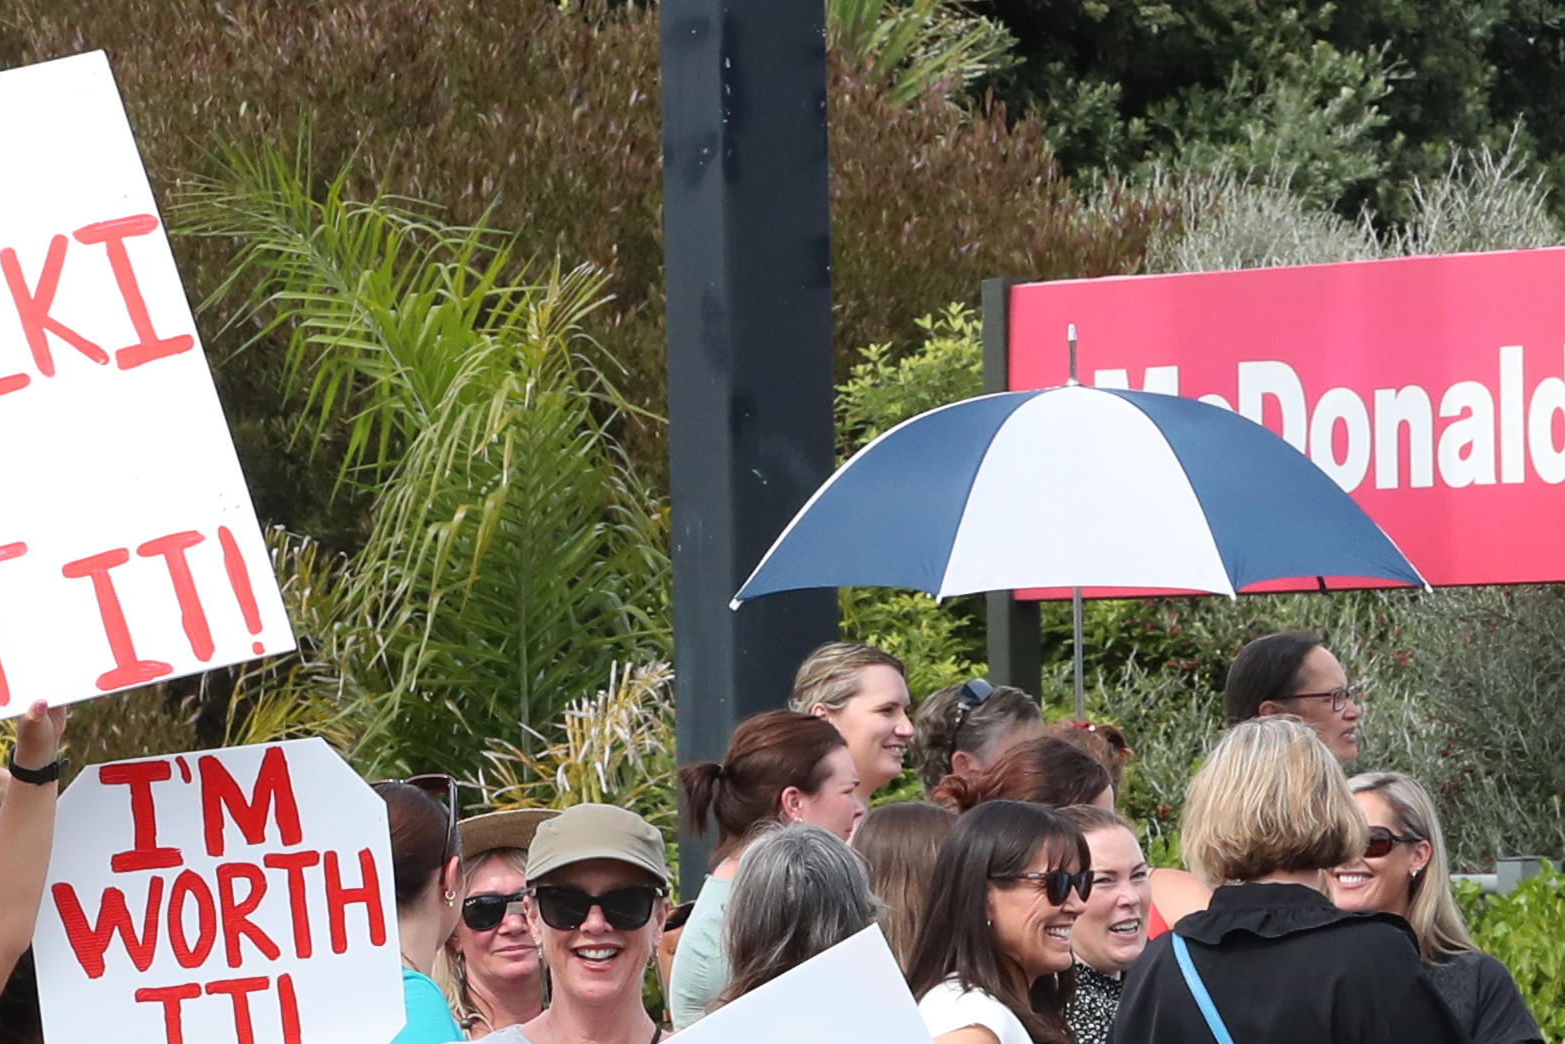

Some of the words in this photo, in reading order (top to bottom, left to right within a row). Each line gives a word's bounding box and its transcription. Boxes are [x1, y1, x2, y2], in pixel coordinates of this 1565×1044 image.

[63, 526, 266, 690] IT!
[99, 746, 303, 873] I'M
[52, 848, 387, 979] WORTH
